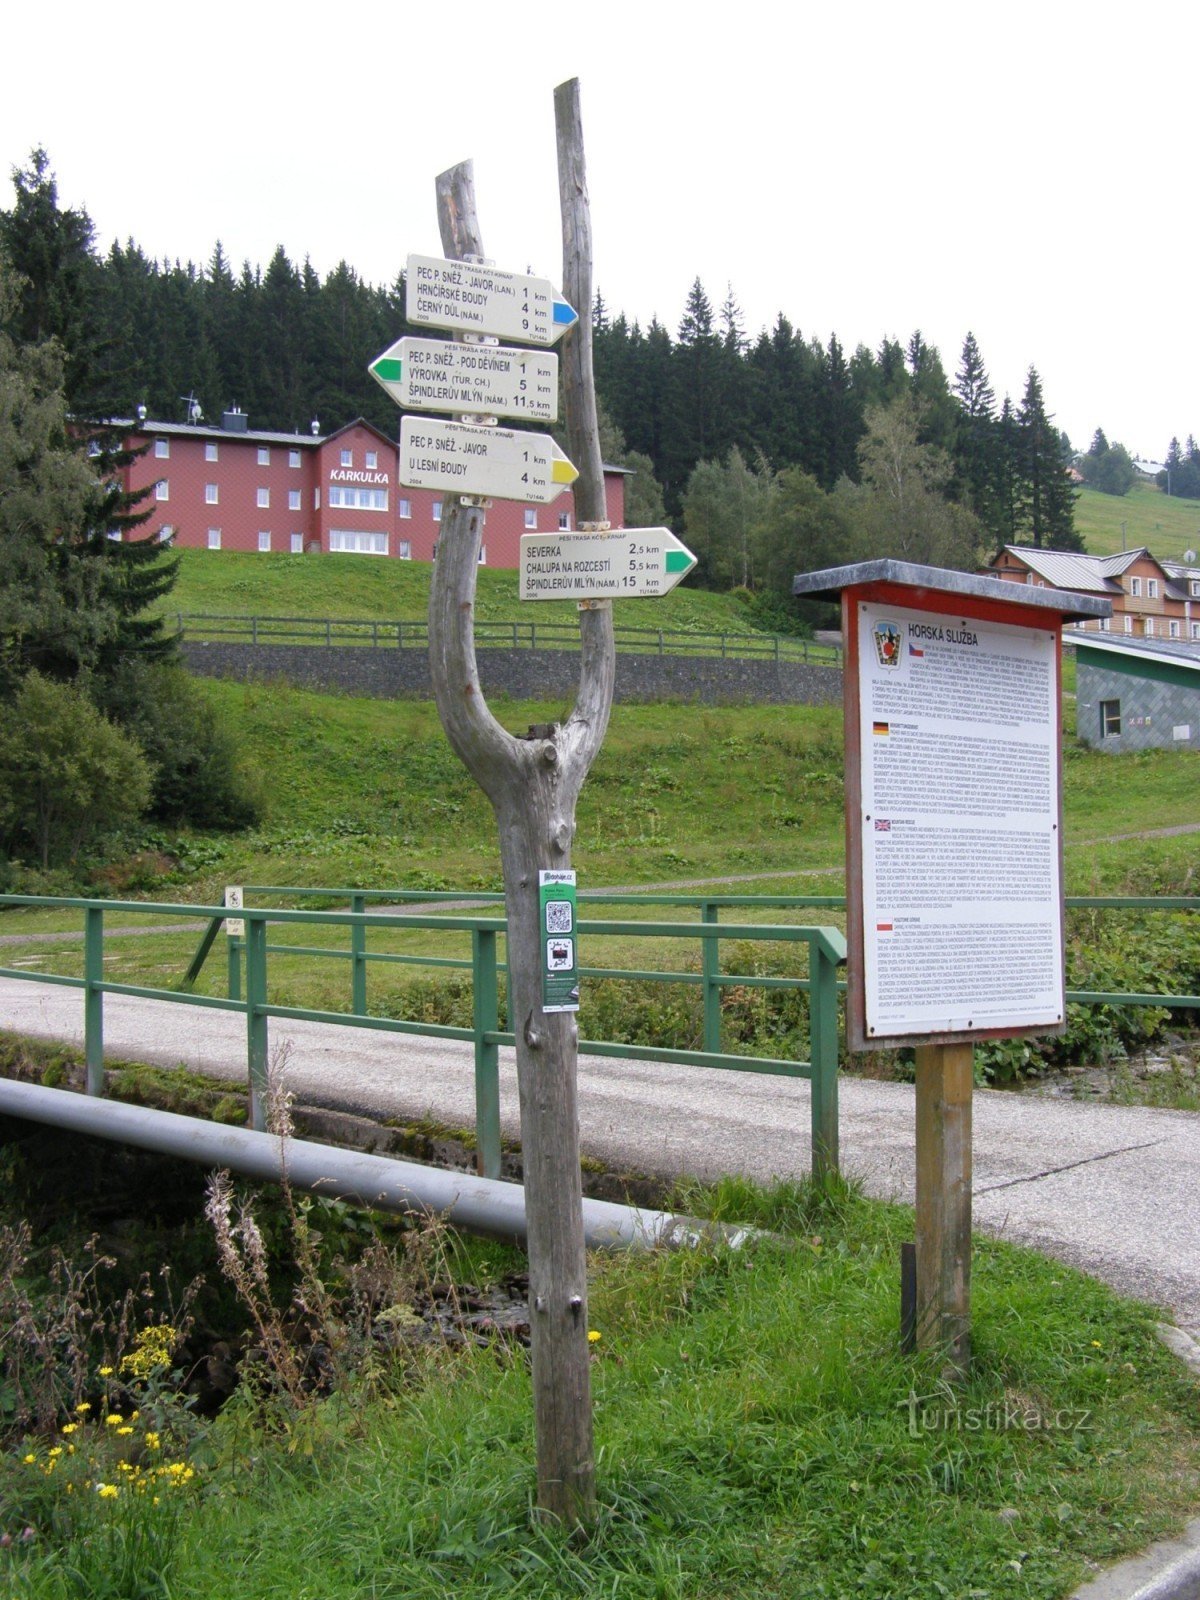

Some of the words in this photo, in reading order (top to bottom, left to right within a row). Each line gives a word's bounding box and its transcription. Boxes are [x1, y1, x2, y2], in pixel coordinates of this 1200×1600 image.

[464, 266, 482, 274] TRASA
[417, 267, 433, 279] PEC
[434, 270, 440, 281] P.
[442, 271, 464, 286] SNĚŽ.
[469, 276, 494, 290] JAVOR
[494, 285, 516, 297] (LAN.)
[522, 287, 528, 298] 1
[534, 293, 547, 302] km
[417, 283, 461, 301] HRNČÍŘSKÉ
[462, 291, 488, 306] BOUDY
[521, 303, 529, 314] 4
[534, 308, 547, 317] km
[417, 297, 442, 314] ČERNÝ
[444, 302, 460, 318] DŮL
[460, 310, 483, 324] (NÁM.)
[522, 319, 529, 330] 9
[534, 324, 547, 333] km
[409, 351, 425, 363] PEC
[426, 353, 433, 364] P.
[434, 353, 455, 366] SNĚŽ.
[461, 357, 476, 368] POD
[478, 356, 510, 372] DĚVÍNEM
[520, 363, 526, 374] 1
[537, 368, 551, 377] km
[409, 366, 448, 382] VÝROVKA
[452, 374, 472, 386] (TUR.
[474, 377, 490, 388] CH.)
[519, 380, 527, 391] 5
[537, 385, 551, 394] km
[409, 381, 459, 400] ŠPINDLERŮV
[461, 388, 483, 402] MLÝN
[484, 394, 508, 406] (NÁM.)
[513, 396, 535, 409] 11,5
[537, 401, 550, 410] km
[410, 435, 426, 448] PEC
[427, 437, 434, 449] P.
[435, 437, 457, 452] SNĚŽ.
[462, 442, 488, 456] JAVOR
[523, 451, 529, 462] 1
[533, 455, 546, 465] km
[330, 469, 389, 484] KARKULKA
[410, 458, 415, 469] U
[416, 458, 440, 472] LESNÍ
[441, 462, 468, 476] BOUDY
[521, 473, 529, 483] 4
[533, 477, 546, 486] km
[526, 546, 562, 558] SEVERKA
[629, 543, 644, 555] 2,5
[646, 545, 659, 554] km
[526, 562, 561, 574] CHALUPA
[562, 562, 572, 573] NA
[575, 557, 611, 572] ROZCESTÍ
[629, 560, 644, 571] 5,5
[646, 562, 659, 571] km
[526, 576, 572, 590] ŠPINDLERŮV
[574, 575, 595, 589] MLÝN
[595, 580, 620, 589] (NÁM.)
[622, 576, 637, 587] 15
[646, 578, 659, 587] km
[908, 623, 944, 642] HORSKÁ
[946, 628, 979, 646] SLUŽBA
